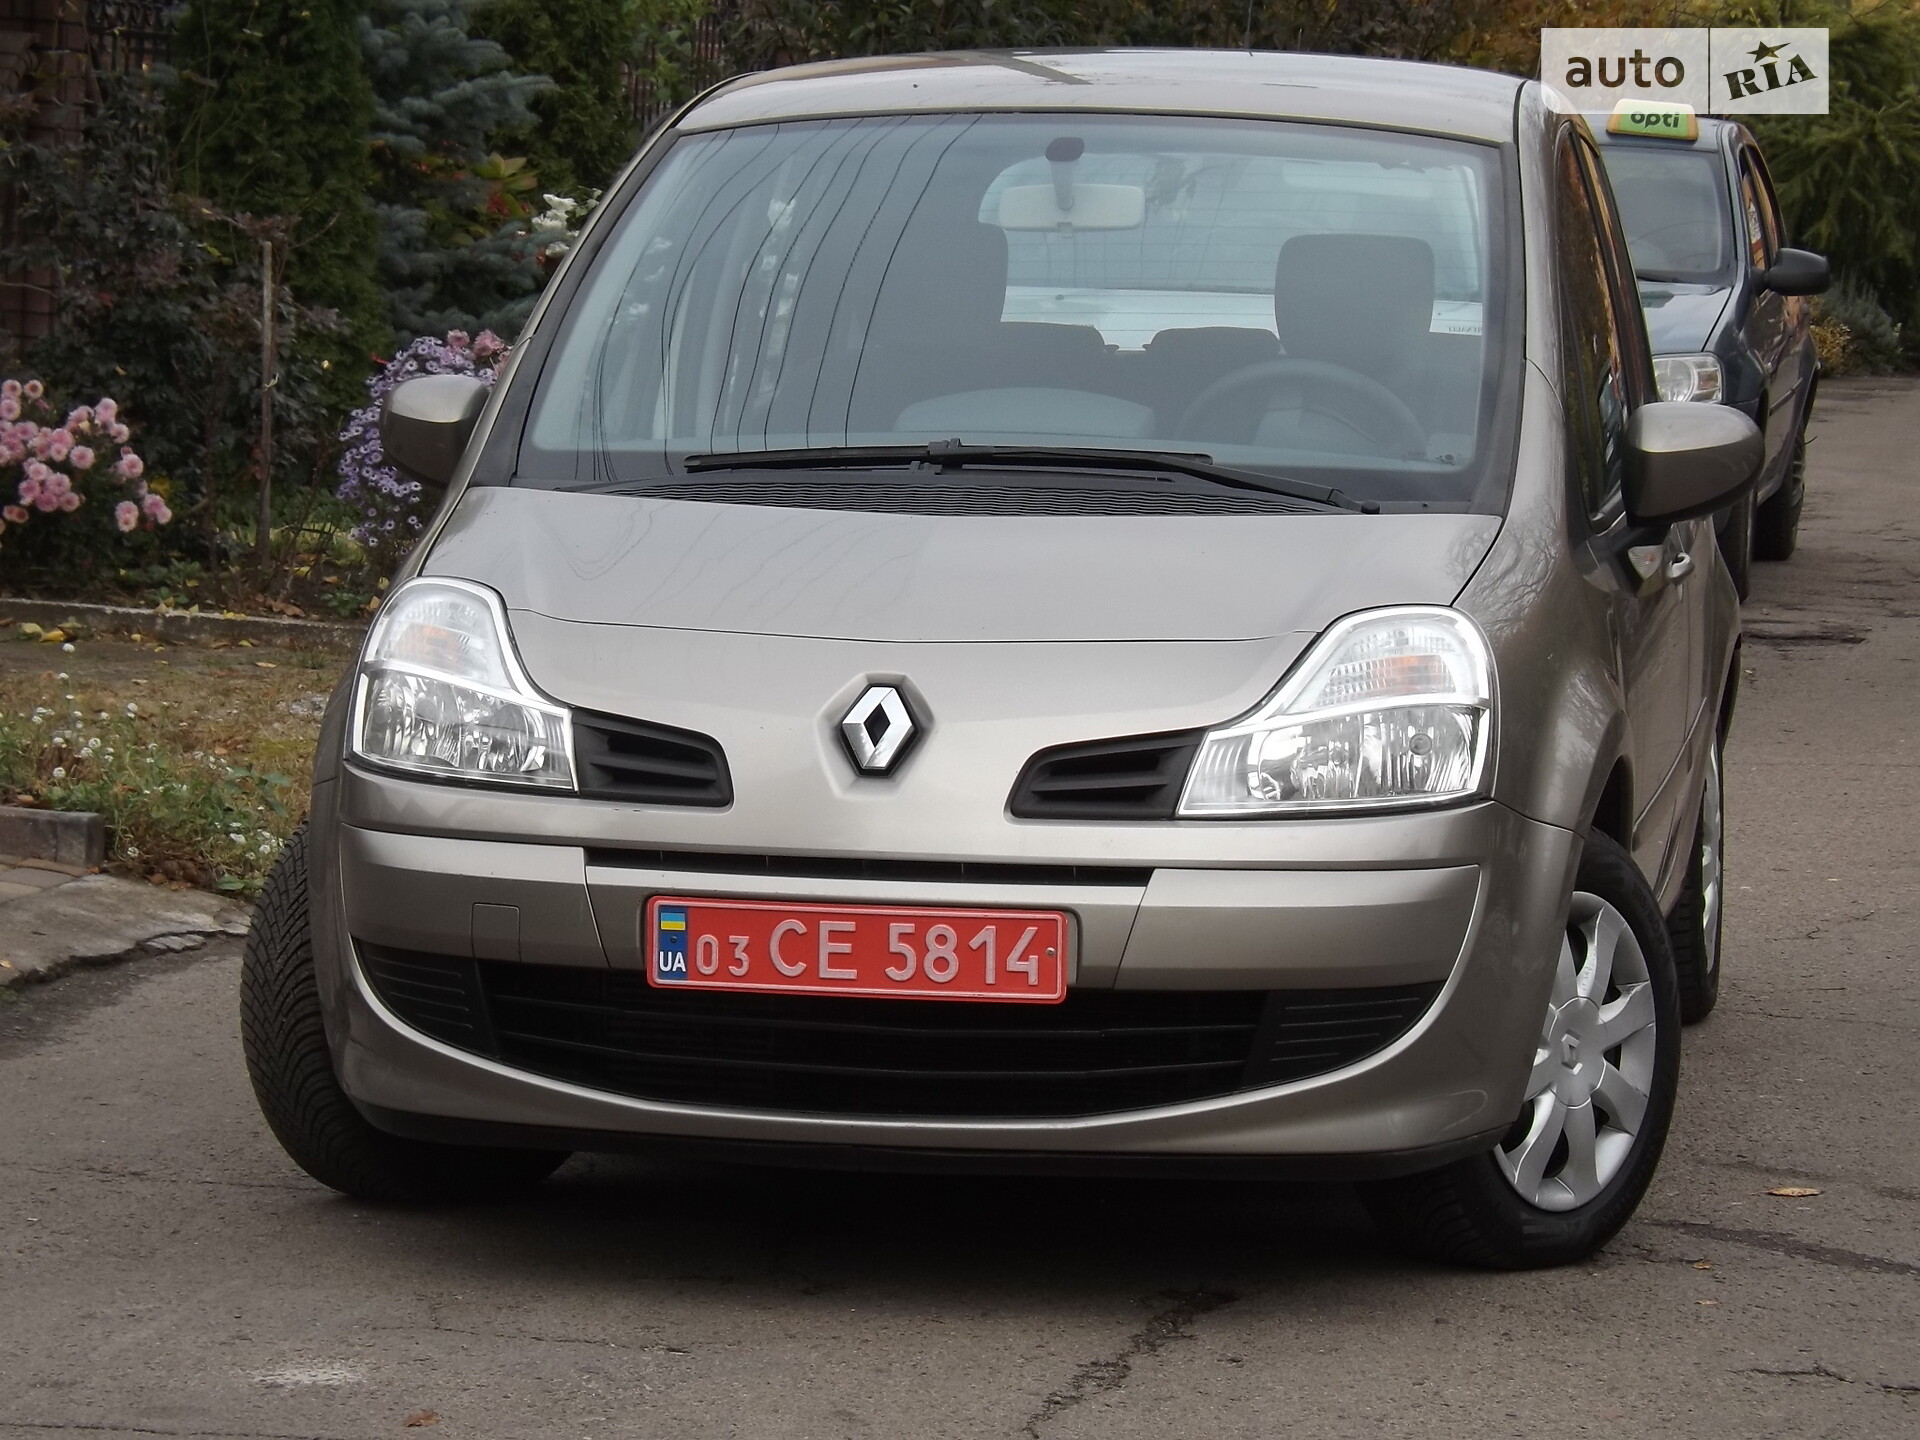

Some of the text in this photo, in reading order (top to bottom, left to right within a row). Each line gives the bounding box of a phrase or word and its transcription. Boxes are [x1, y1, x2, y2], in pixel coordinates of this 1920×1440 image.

[1630, 111, 1680, 128] opti
[659, 950, 687, 973] UA
[695, 919, 1040, 986] 03 CE 5814
